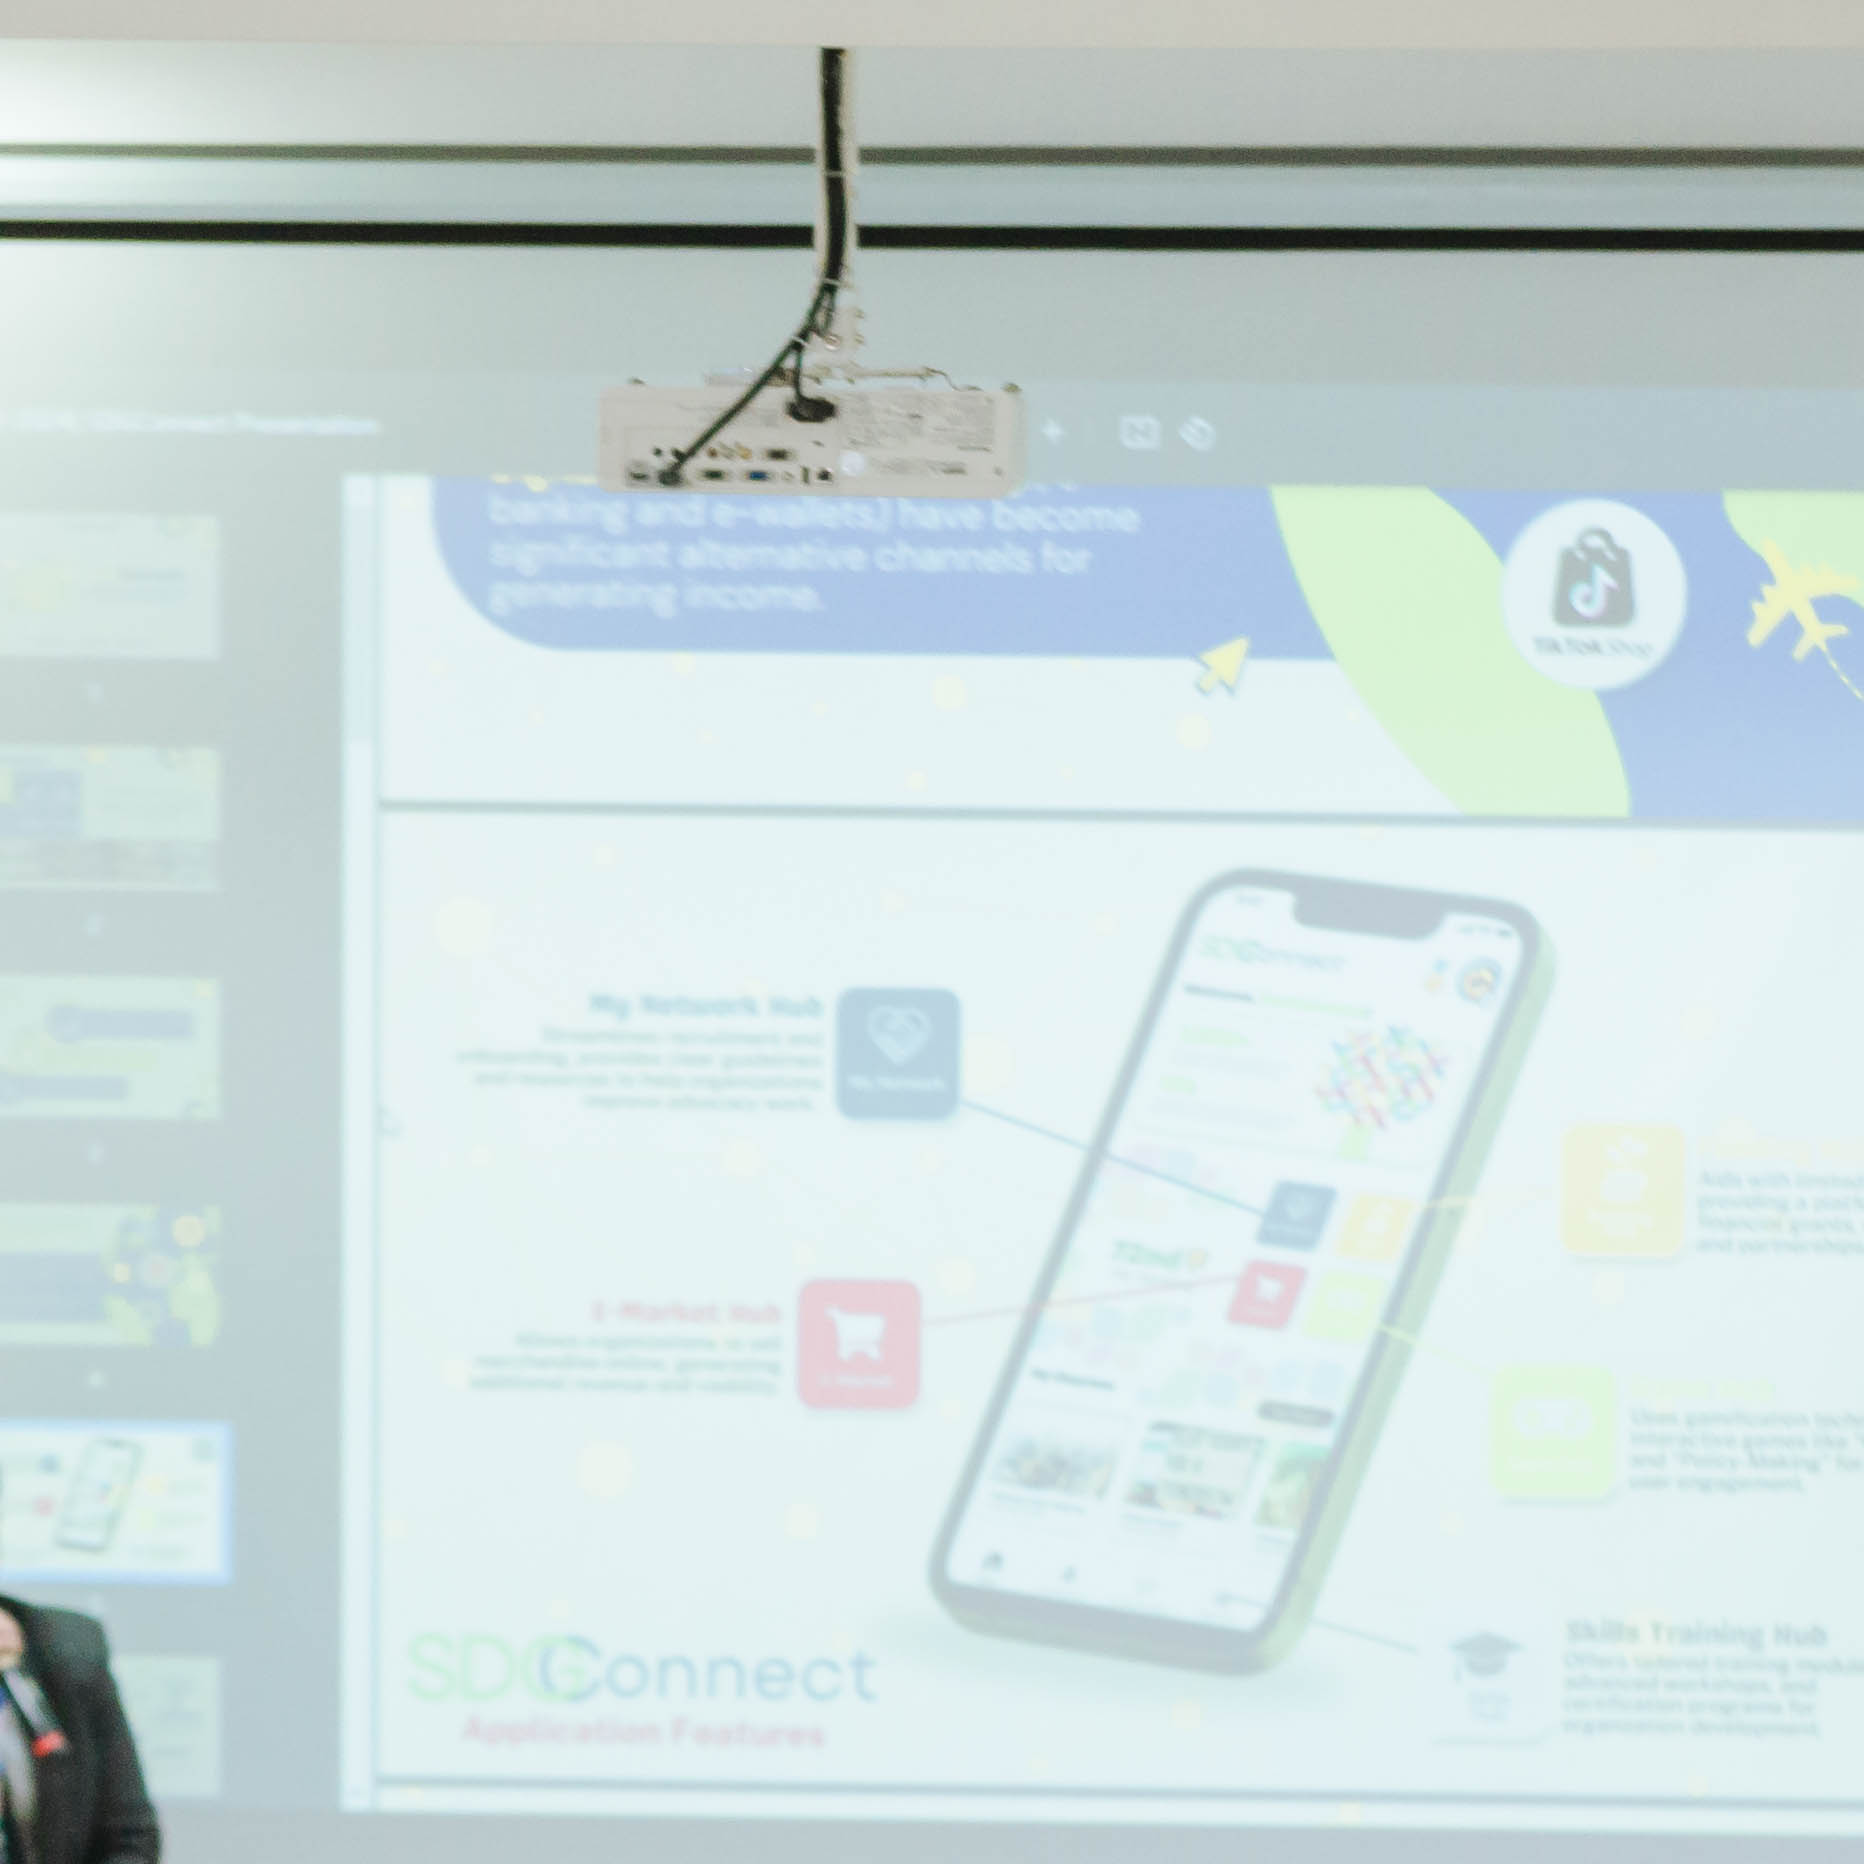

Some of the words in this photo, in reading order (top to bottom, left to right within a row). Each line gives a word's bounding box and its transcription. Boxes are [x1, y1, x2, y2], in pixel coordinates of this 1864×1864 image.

[637, 498, 703, 526] and
[897, 500, 984, 530] have
[991, 502, 1139, 532] become
[489, 541, 669, 576] significant
[677, 542, 867, 571] alternative
[874, 545, 1034, 573] channels
[1041, 545, 1091, 573] for
[489, 582, 677, 618] generating
[1649, 1619, 1765, 1650] Training
[1773, 1622, 1828, 1647] Hub
[461, 1716, 660, 1745] Application
[670, 1716, 826, 1747] Features
